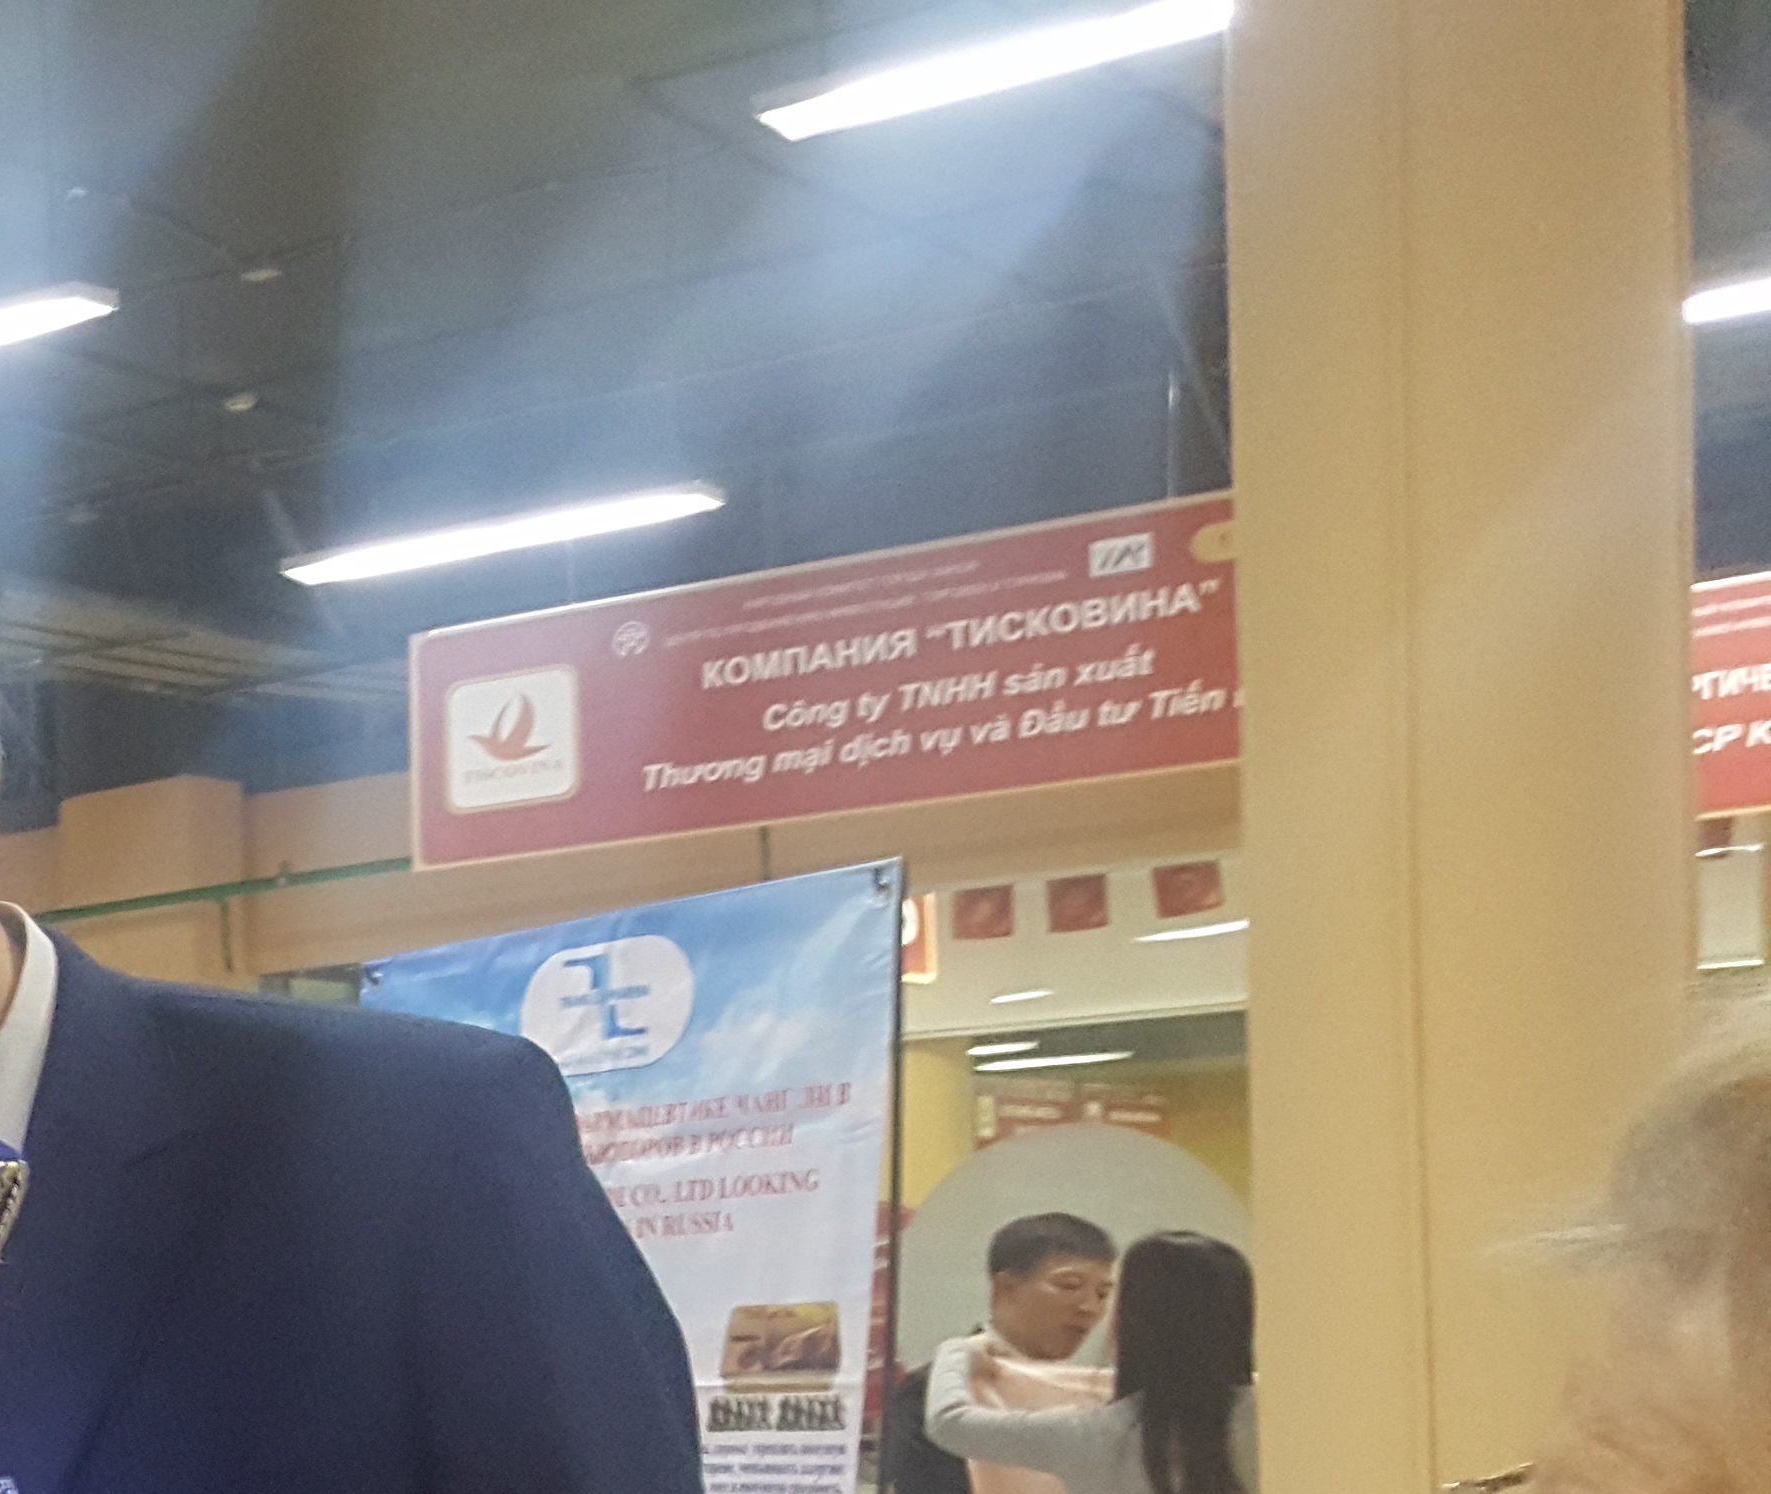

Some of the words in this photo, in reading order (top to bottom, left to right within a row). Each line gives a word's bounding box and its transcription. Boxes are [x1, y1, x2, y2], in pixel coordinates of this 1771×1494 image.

[702, 627, 917, 690] КОМПАНИЯ
[763, 699, 850, 731] Công
[856, 691, 892, 723] ty
[899, 670, 999, 711] TNHH
[1003, 662, 1066, 696] sản
[1074, 643, 1156, 687] xuất
[772, 738, 833, 775] mại
[840, 728, 911, 769] dịch
[920, 726, 962, 756] vụ
[970, 714, 1011, 745] và
[1018, 699, 1089, 739] Đầu
